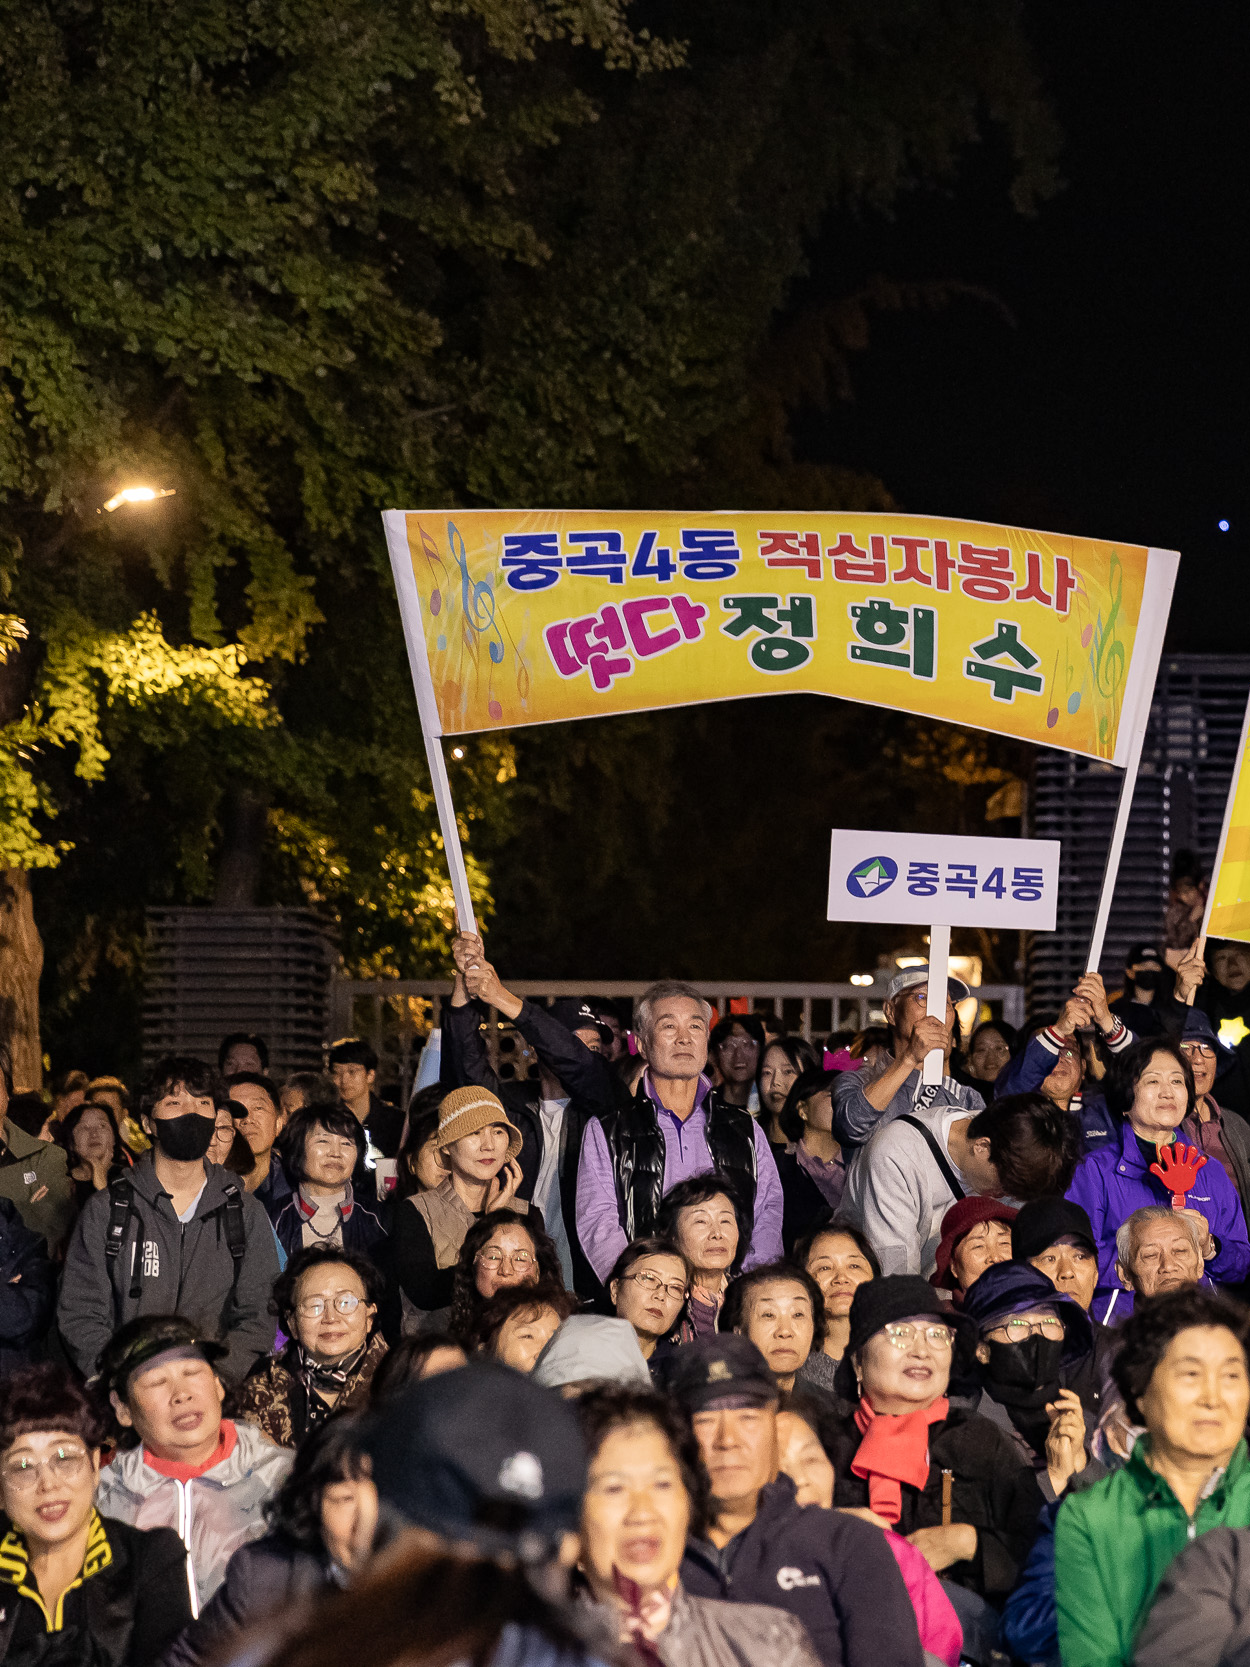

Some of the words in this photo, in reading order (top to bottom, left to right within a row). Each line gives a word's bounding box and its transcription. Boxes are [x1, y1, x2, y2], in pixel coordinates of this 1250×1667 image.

[501, 529, 740, 591] 중곡4동
[758, 531, 1077, 613] 적십자봉사
[906, 861, 1045, 902] 중곡4동
